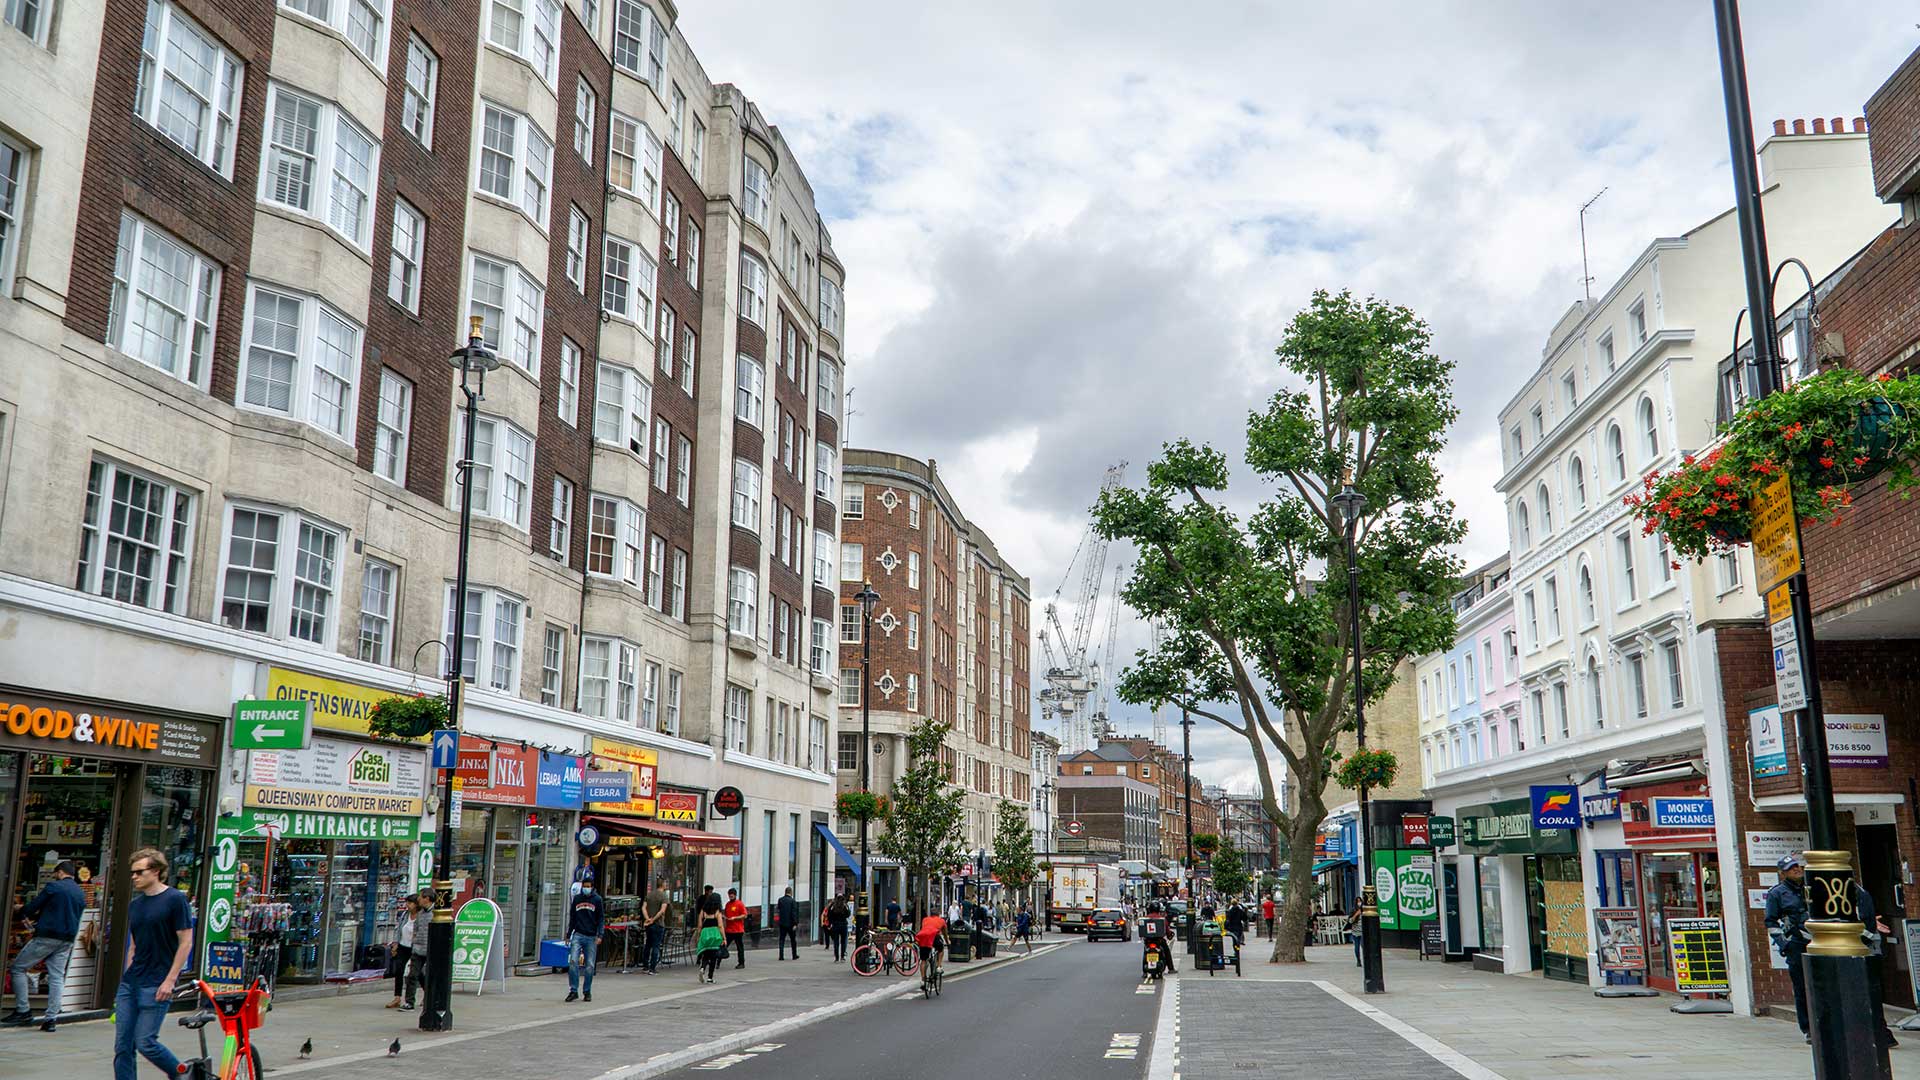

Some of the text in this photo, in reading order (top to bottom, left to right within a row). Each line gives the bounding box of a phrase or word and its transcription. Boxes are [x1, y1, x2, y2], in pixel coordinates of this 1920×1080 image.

[276, 684, 372, 720] QUEENSWAY
[240, 710, 300, 720] ENTRANCE
[362, 750, 384, 766] Casa
[353, 760, 390, 783] Brasil
[563, 766, 582, 784] AMK
[469, 776, 488, 786] Shop
[540, 772, 561, 786] LEBARA
[590, 788, 620, 797] LEBARA
[257, 789, 412, 812] QUEENSWAY COMPUTER MARKET
[660, 810, 694, 820] TAZA
[1584, 798, 1613, 818] CORAL
[1667, 803, 1704, 813] MONEY
[294, 814, 377, 837] ENTRANCE
[1539, 817, 1576, 825] CORAL
[1661, 815, 1714, 824] EXCHANGE
[210, 965, 242, 980] ATM
